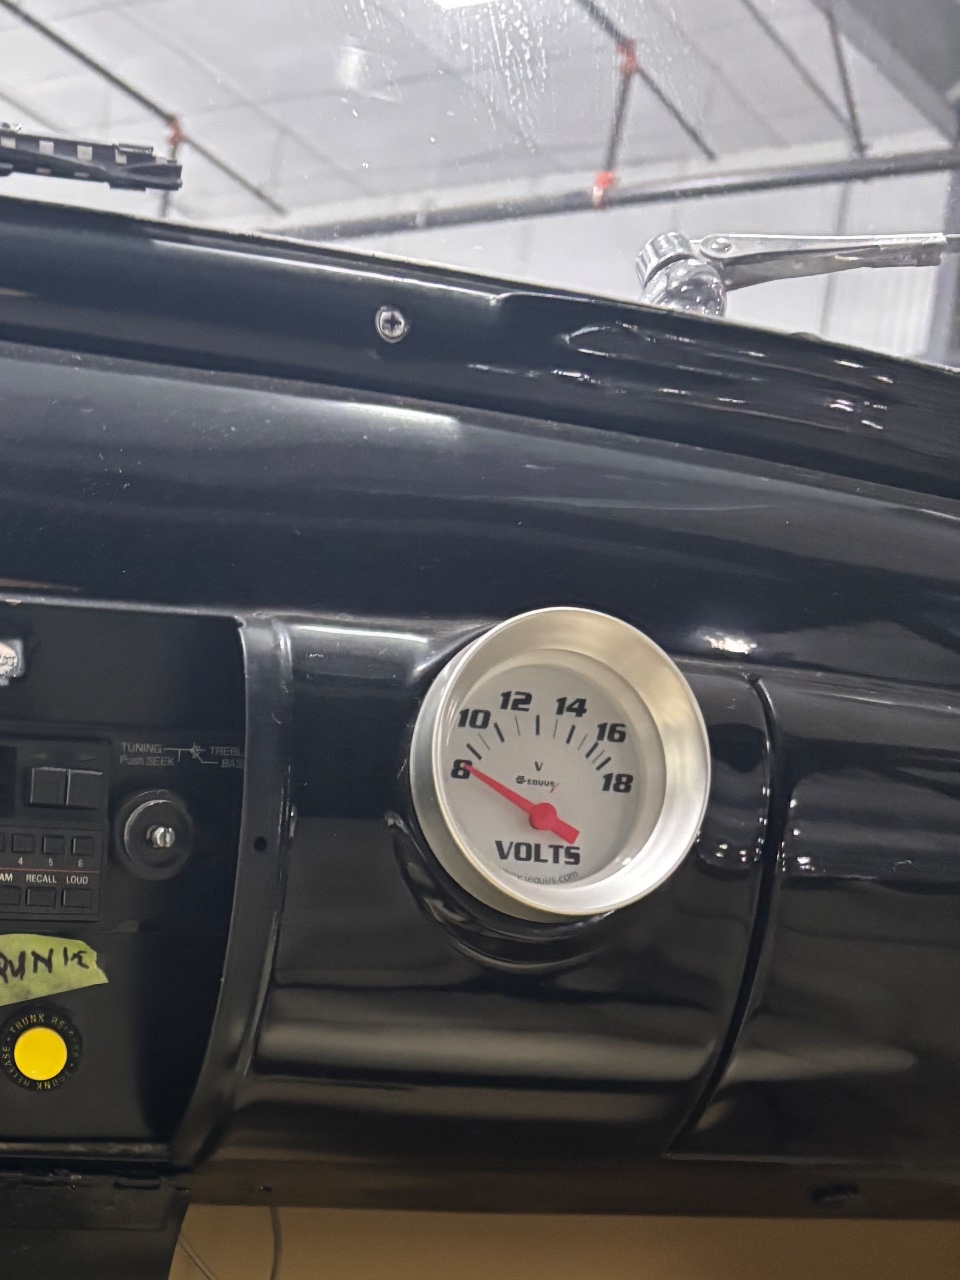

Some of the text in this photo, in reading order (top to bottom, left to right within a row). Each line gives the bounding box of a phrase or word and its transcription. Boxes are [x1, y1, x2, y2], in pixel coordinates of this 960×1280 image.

[500, 691, 533, 711] 12
[556, 697, 587, 717] 14
[458, 708, 491, 730] 10
[596, 722, 627, 743] 16
[121, 742, 162, 754] TUNING
[120, 755, 175, 766] Push SEEK
[450, 759, 473, 780] 8
[534, 761, 543, 771] V
[602, 773, 634, 793] 18
[18, 857, 24, 866] 4
[48, 858, 53, 867] 5
[78, 859, 83, 868] 6
[495, 840, 581, 865] VOLTS
[26, 874, 57, 884] RECALL
[66, 875, 88, 885] LOUD
[10, 1013, 45, 1033] TRUNK
